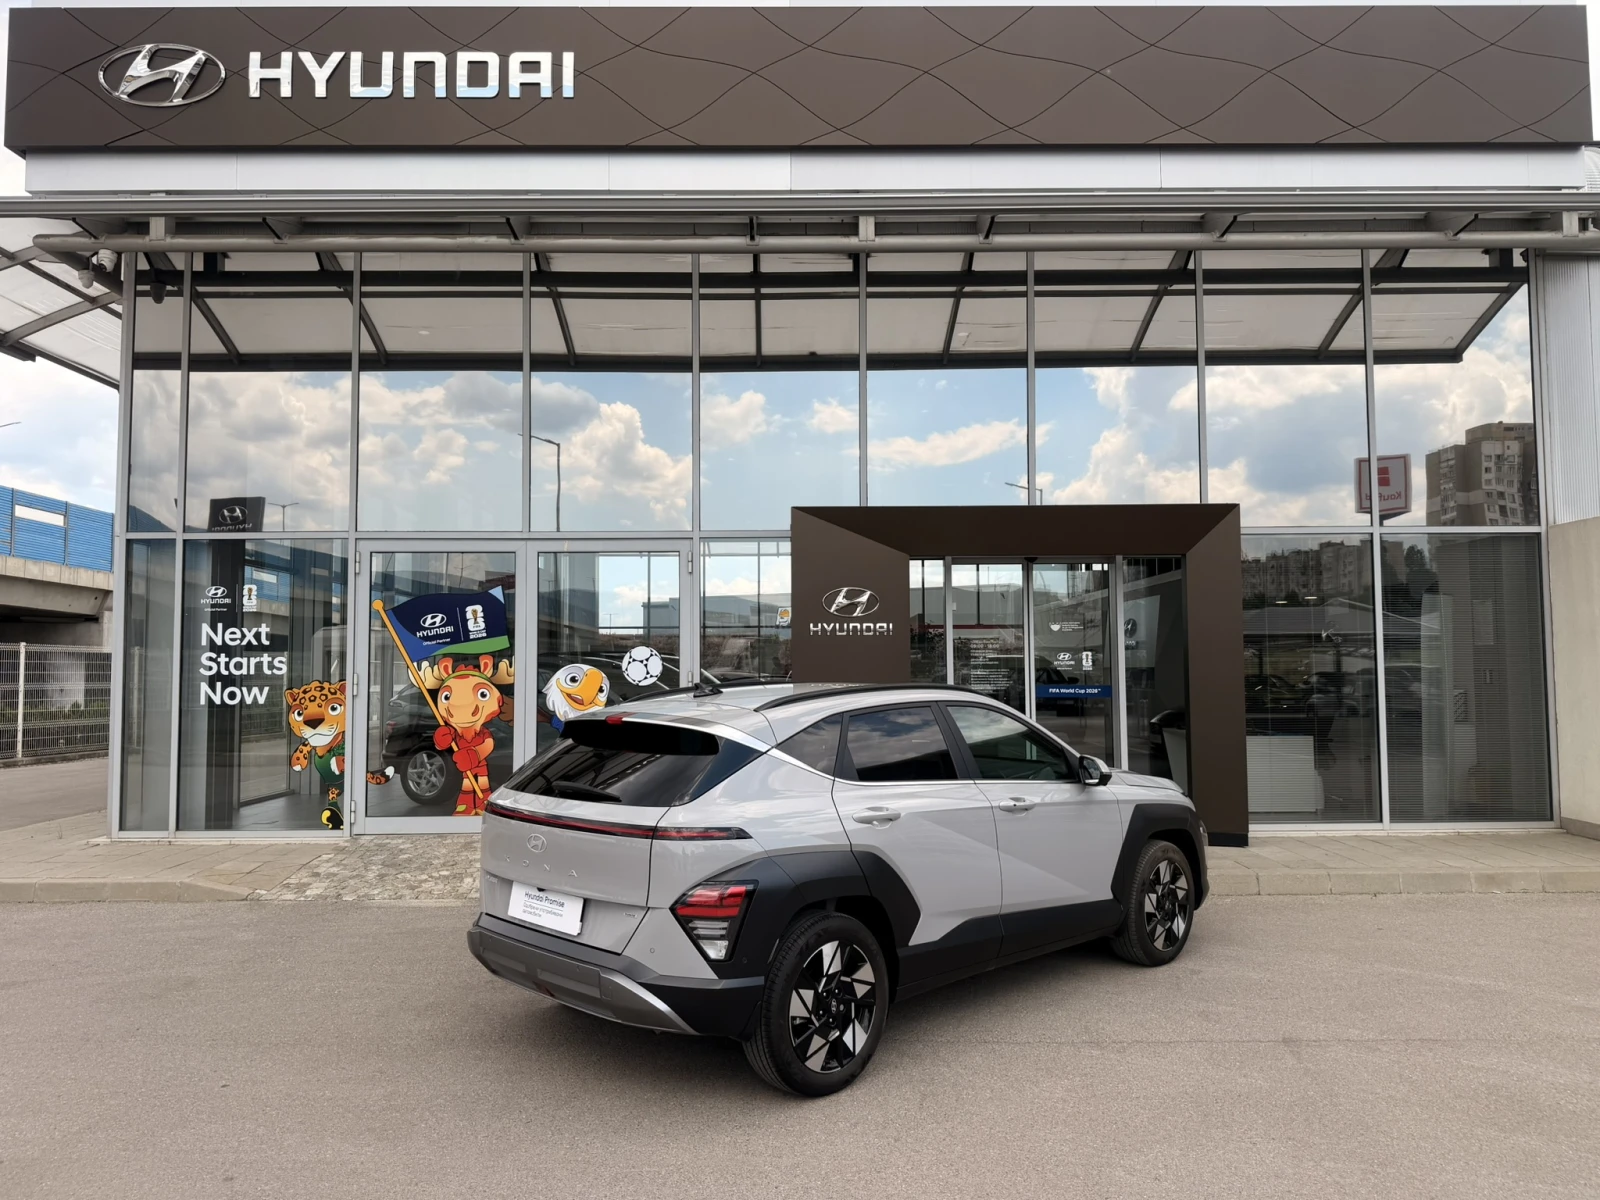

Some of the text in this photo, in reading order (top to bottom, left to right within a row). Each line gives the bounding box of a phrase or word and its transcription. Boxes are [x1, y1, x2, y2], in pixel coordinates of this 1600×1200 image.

[248, 51, 575, 99] HYUNDAI
[201, 622, 271, 646] Next
[416, 625, 454, 638] HYUNDAI
[809, 622, 893, 636] HYUNDAI
[199, 652, 288, 676] Starts
[200, 681, 269, 706] Now
[505, 854, 578, 877] KONA
[524, 890, 566, 908] Hyundai Promise
